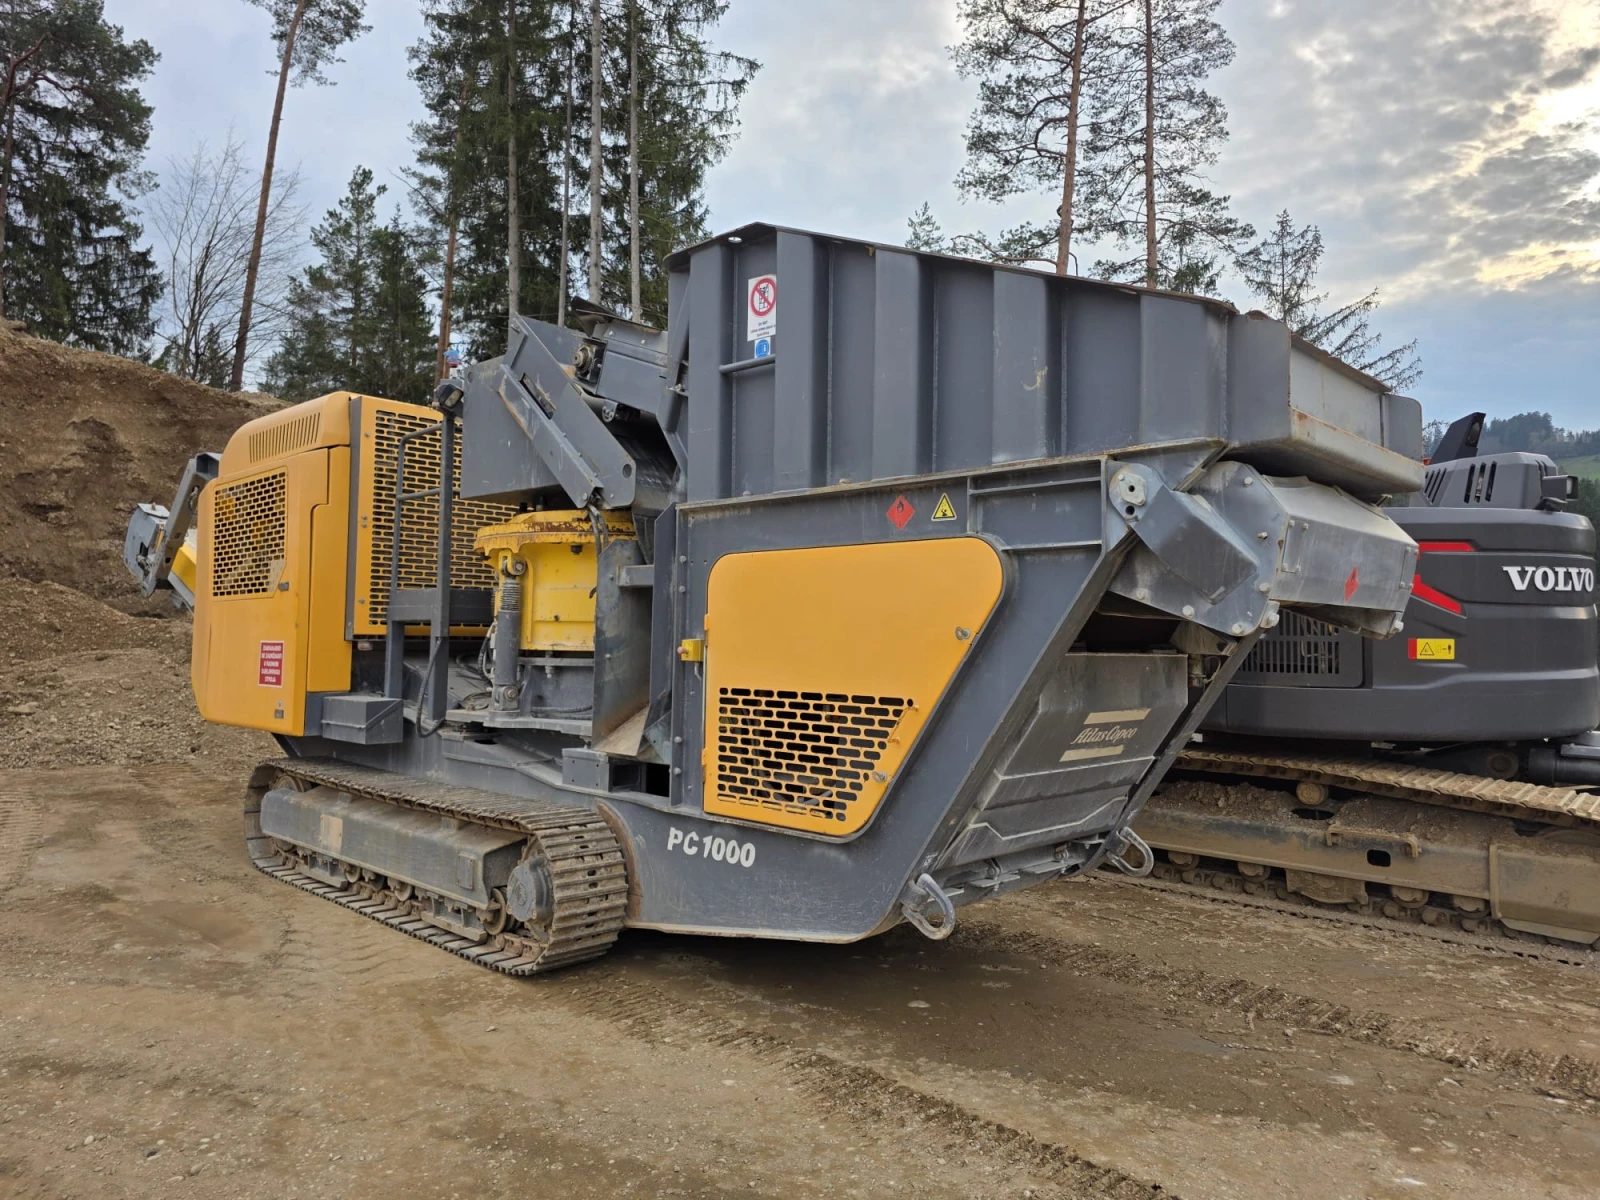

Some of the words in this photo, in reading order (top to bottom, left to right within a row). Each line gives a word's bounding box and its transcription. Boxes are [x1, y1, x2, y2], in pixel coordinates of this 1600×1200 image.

[1501, 565, 1594, 592] VOLVO
[1070, 727, 1106, 745] Atlas
[1106, 725, 1138, 743] Copco
[667, 826, 700, 856] PC
[702, 834, 756, 868] 1000
